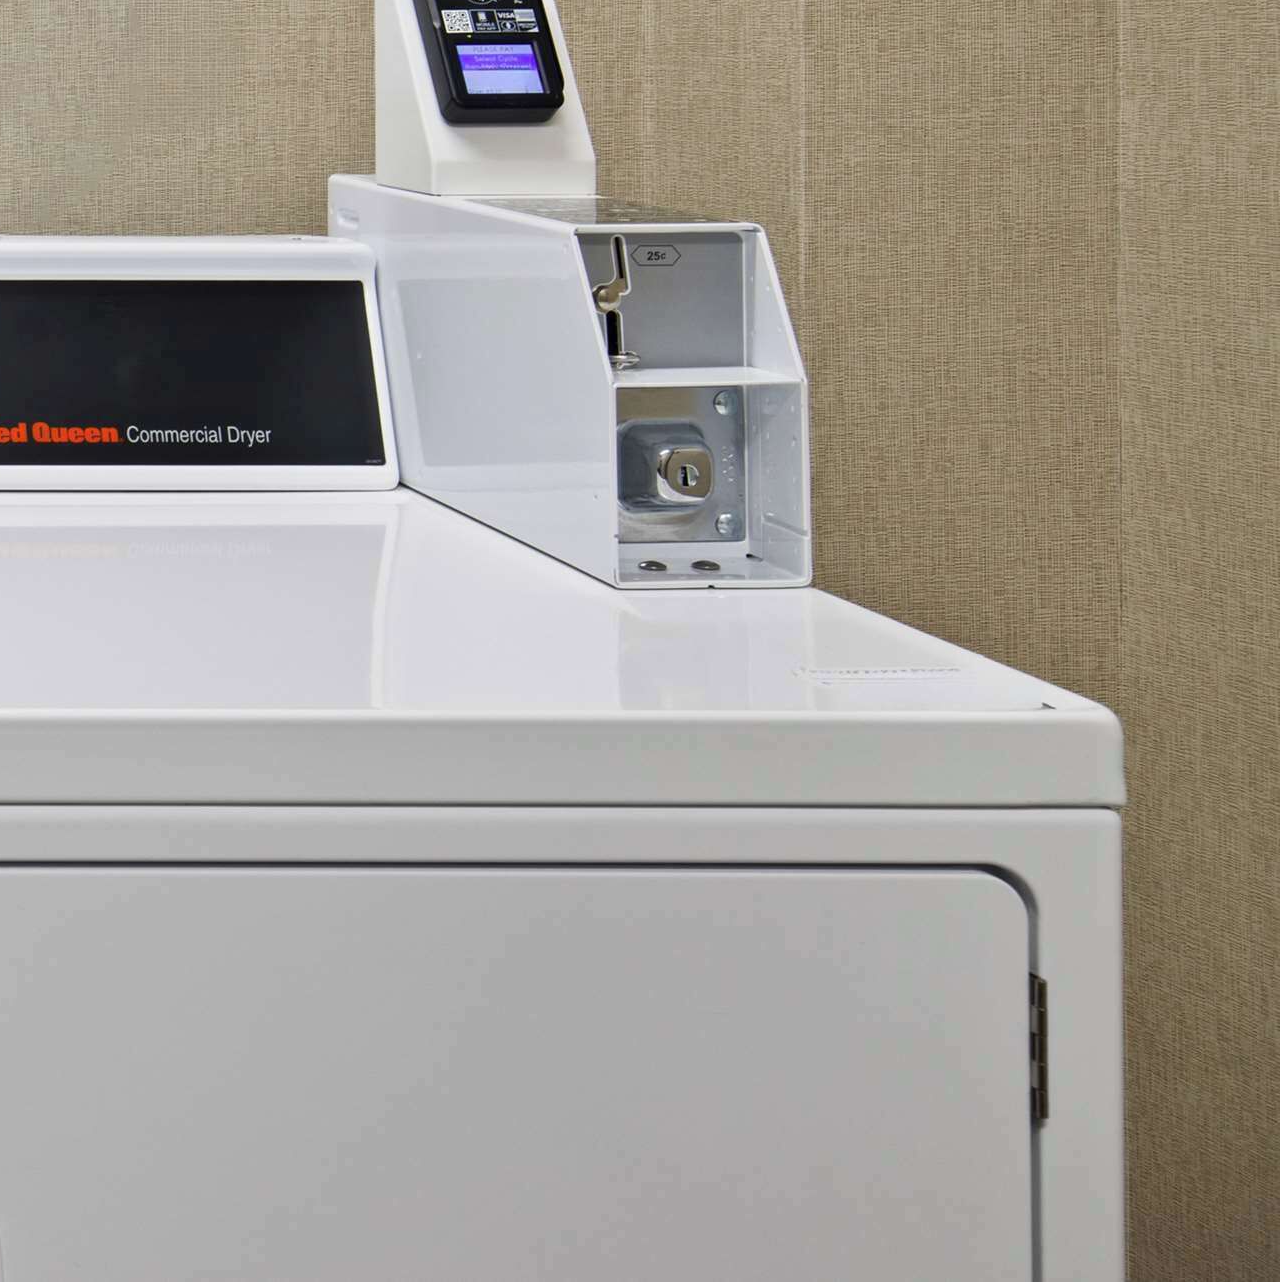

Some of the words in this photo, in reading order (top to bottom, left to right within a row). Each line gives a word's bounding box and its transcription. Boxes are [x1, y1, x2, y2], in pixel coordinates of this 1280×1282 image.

[32, 421, 119, 444] Queen
[126, 425, 223, 444] Commercial
[226, 425, 272, 448] Dryer
